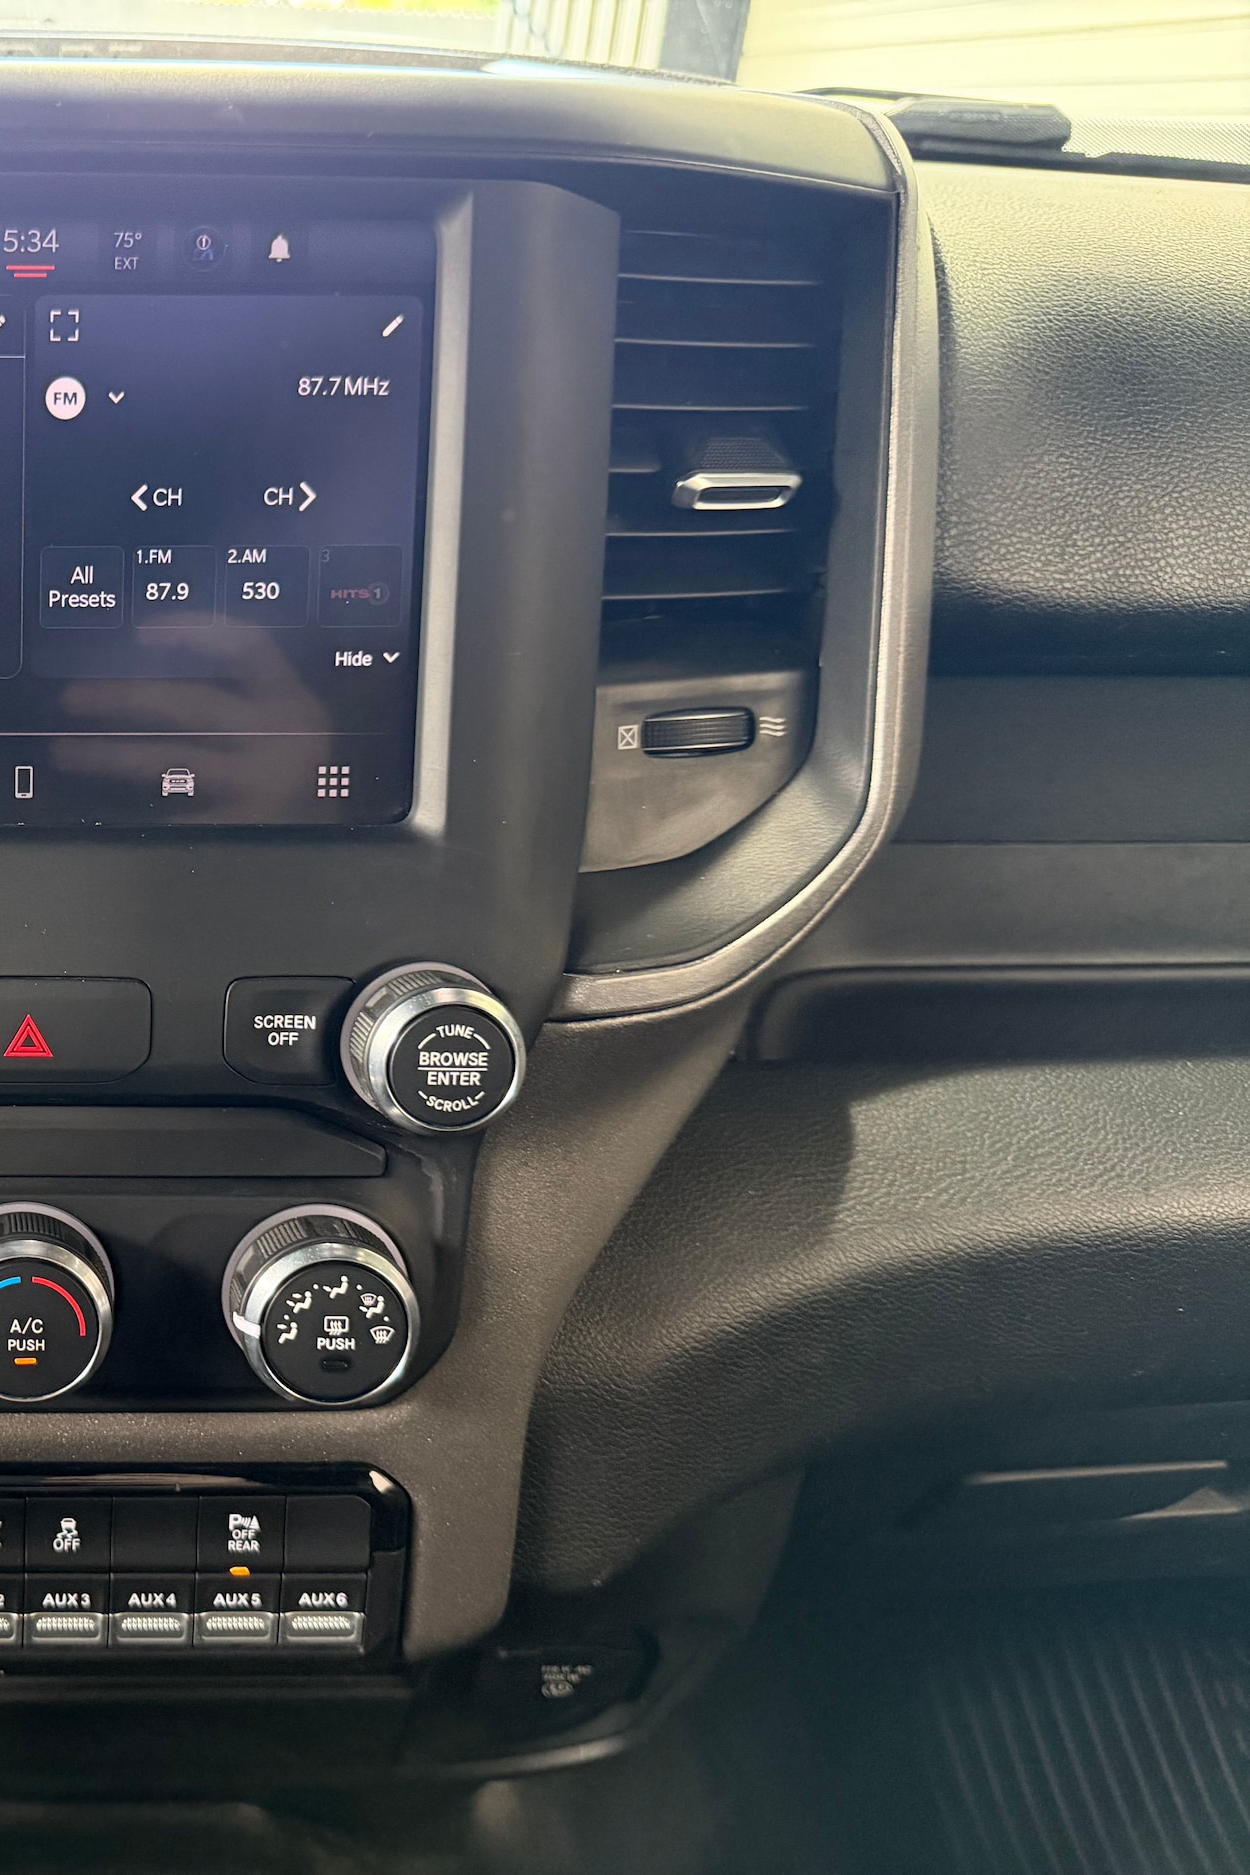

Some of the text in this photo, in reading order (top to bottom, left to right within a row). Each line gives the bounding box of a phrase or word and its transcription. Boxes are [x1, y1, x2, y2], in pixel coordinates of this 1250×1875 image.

[2, 228, 59, 253] 5:34
[113, 257, 139, 271] EXT
[53, 392, 77, 406] FM
[152, 488, 183, 507] CH
[263, 488, 294, 507] CH
[70, 566, 94, 585] All
[145, 582, 189, 601] 87.9
[241, 581, 280, 601] 530
[48, 591, 116, 609] Presets
[334, 651, 373, 668] Hide
[253, 1015, 317, 1030] SCREEN
[267, 1031, 299, 1046] OFF
[435, 1023, 475, 1041] TUNE
[418, 1051, 489, 1067] BROWSE
[426, 1071, 481, 1086] ENTER
[425, 1095, 479, 1112] SCROLL
[10, 1318, 44, 1336] A/C
[7, 1339, 46, 1352] PUSH
[316, 1337, 356, 1350] PUSH
[232, 1529, 256, 1540] OFF
[52, 1538, 81, 1552] OFF
[228, 1540, 259, 1552] REAR
[42, 1593, 91, 1607] AUX 3
[128, 1593, 177, 1607] AUX 4
[213, 1593, 262, 1607] AUX 5
[298, 1593, 348, 1607] AUX 6
